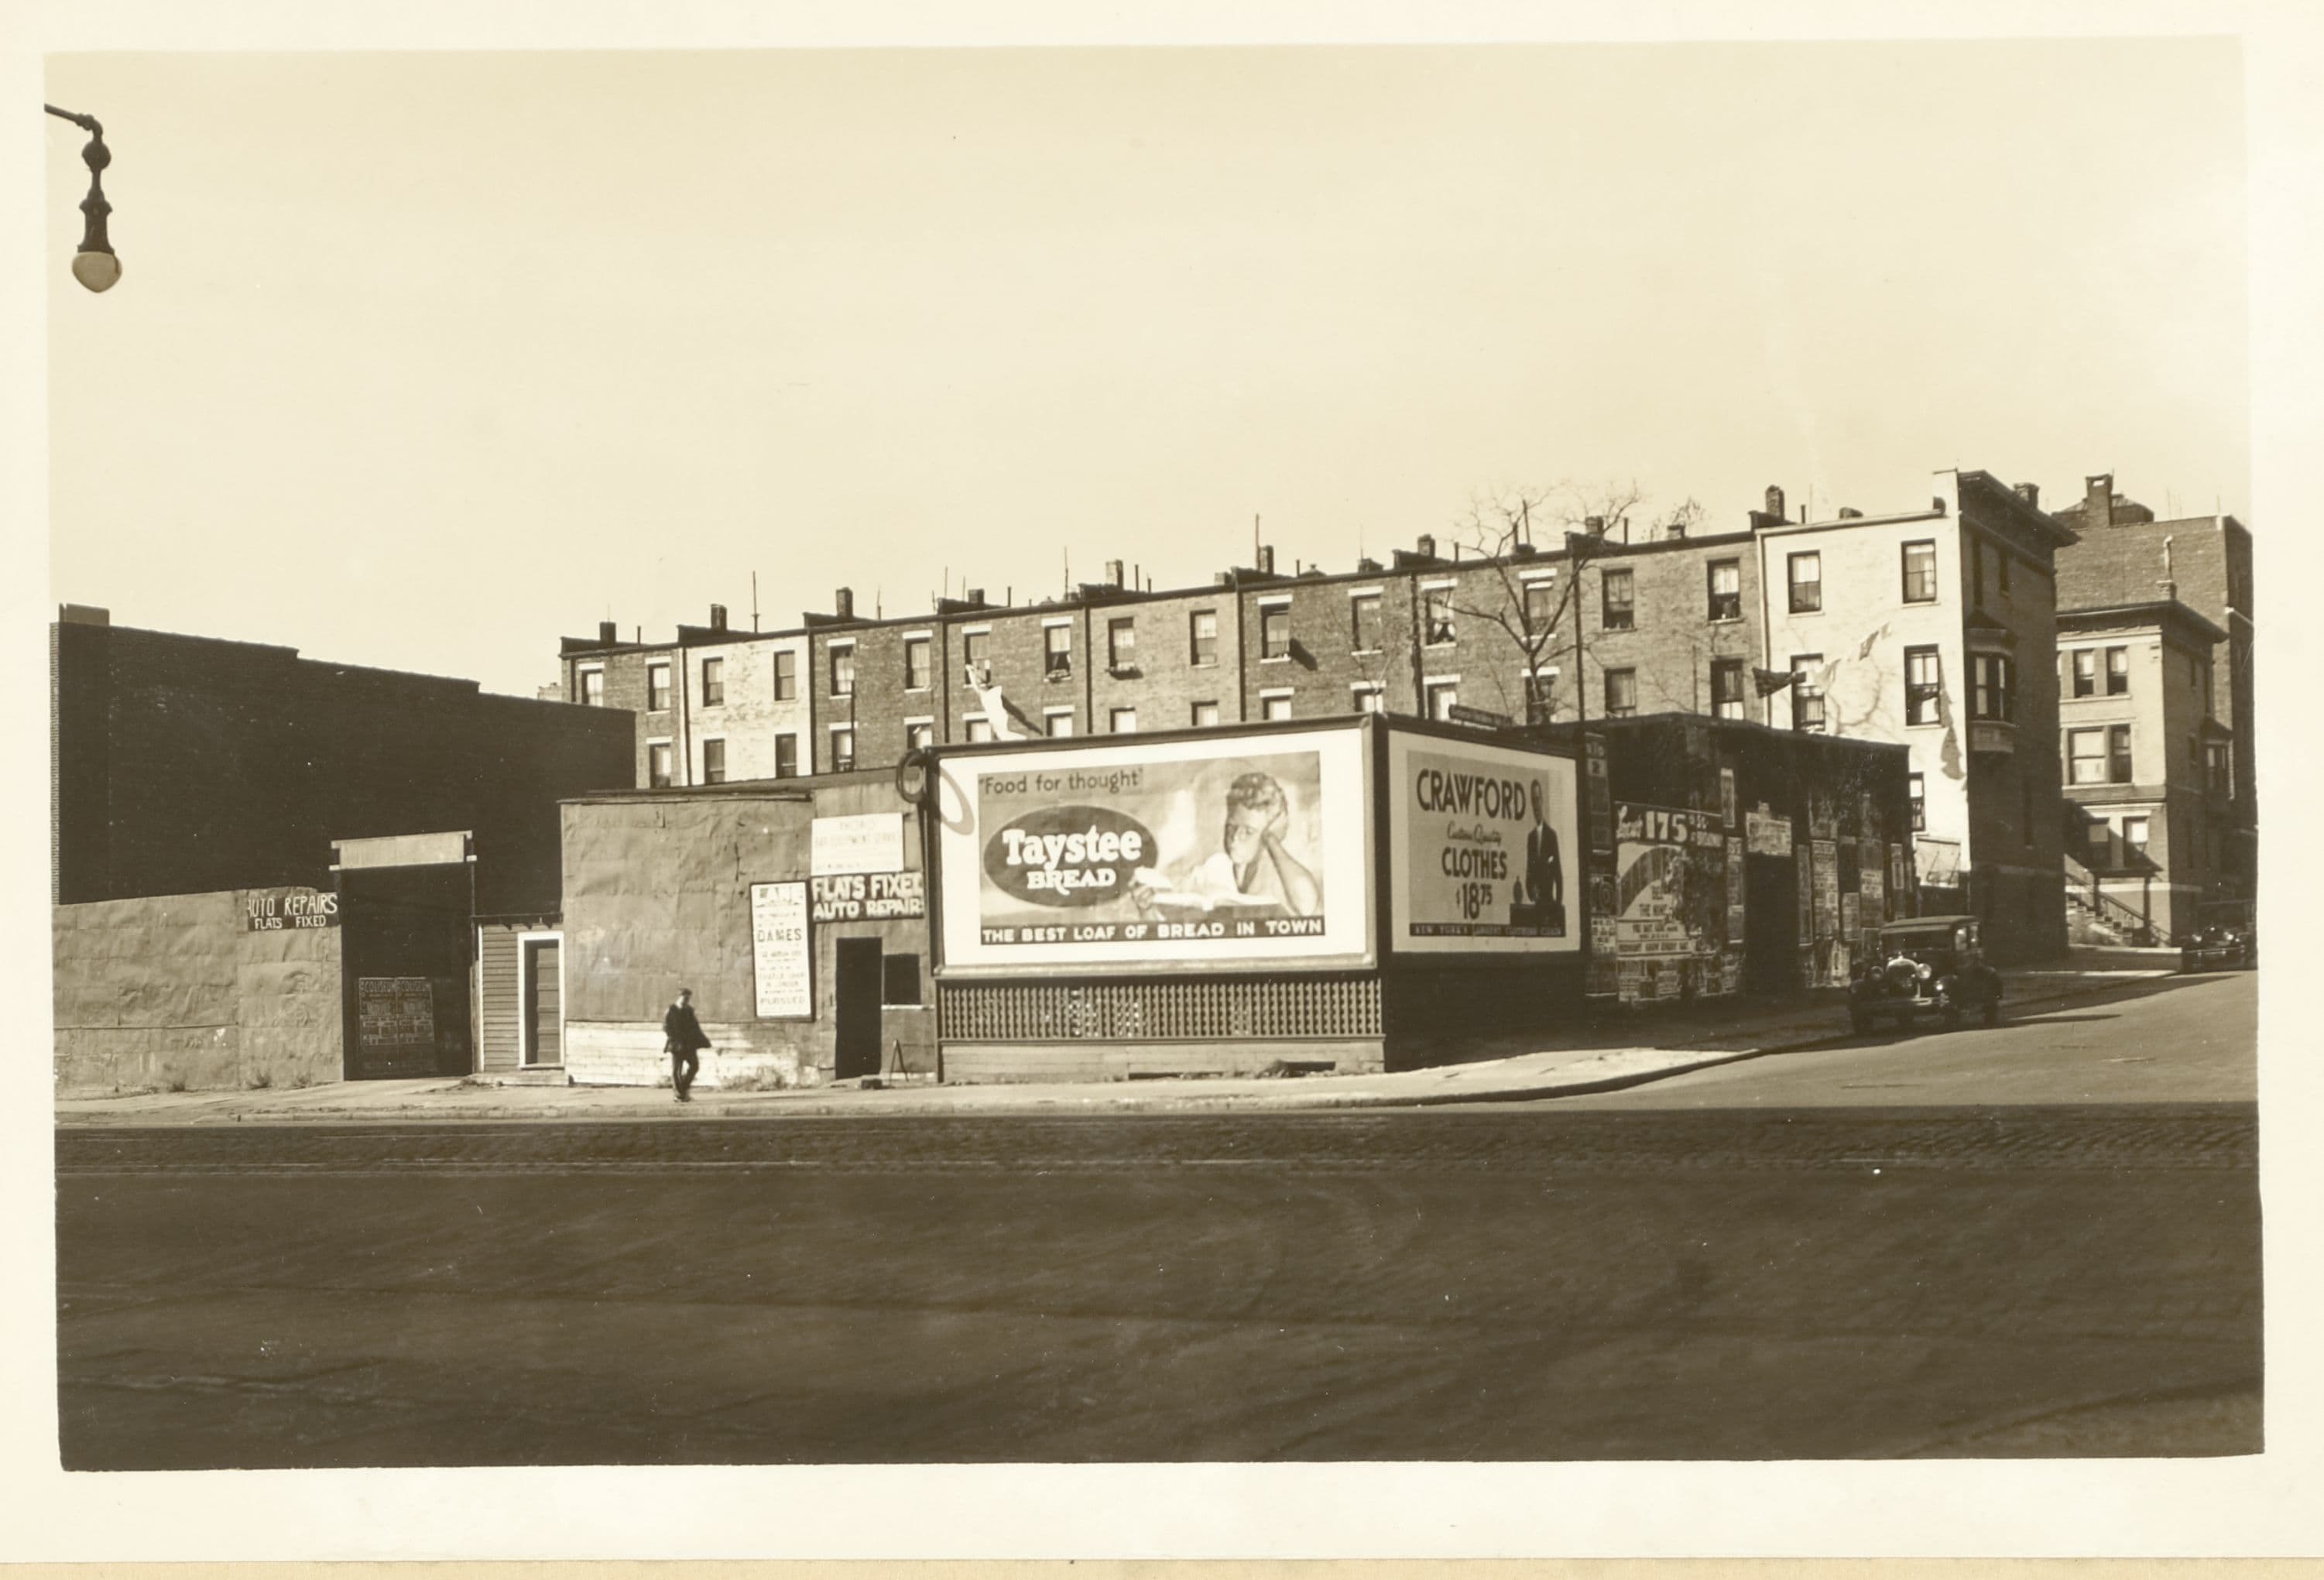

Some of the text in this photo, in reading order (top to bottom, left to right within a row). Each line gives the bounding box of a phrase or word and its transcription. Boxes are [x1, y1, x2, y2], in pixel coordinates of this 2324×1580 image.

[1036, 773, 1061, 792] for
[1417, 769, 1526, 821] CRAWFORD
[1646, 811, 1688, 842] 175
[1003, 828, 1141, 871] Taystee
[1442, 847, 1507, 880] CLOTHES
[811, 875, 865, 902] FLATS
[1027, 869, 1116, 895] BREAD
[248, 894, 338, 917] AUTO REPAIRS
[813, 901, 859, 922] AUTO
[255, 915, 326, 930] FLATS FIXED
[983, 920, 1321, 943] THE BEST LOAF OF BREAD IN TOWN
